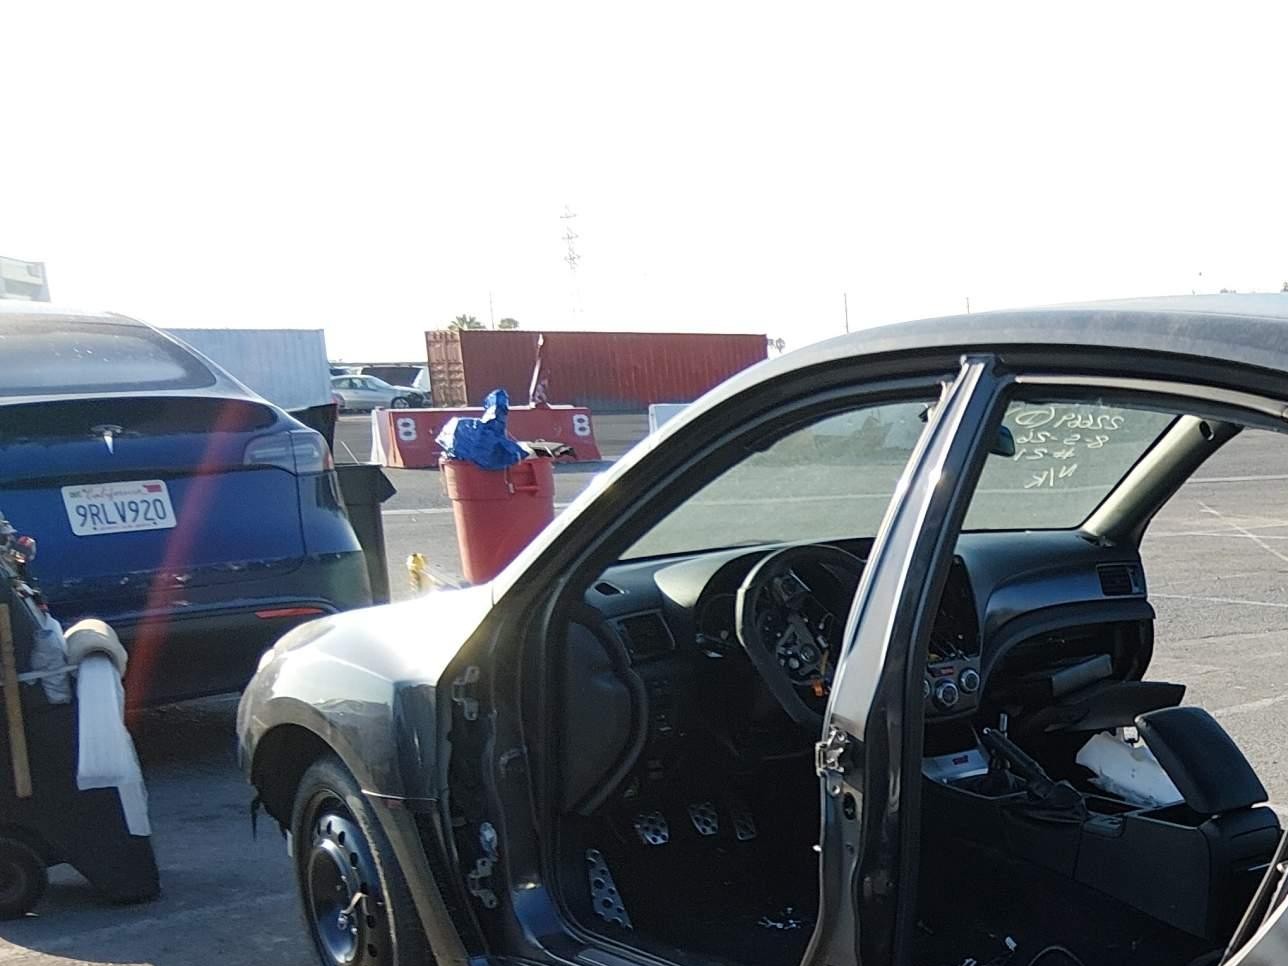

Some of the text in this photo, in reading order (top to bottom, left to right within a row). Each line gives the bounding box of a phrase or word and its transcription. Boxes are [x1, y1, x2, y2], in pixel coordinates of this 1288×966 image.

[397, 417, 417, 441] 8
[573, 414, 591, 437] 8
[75, 498, 167, 528] 9RLV920
